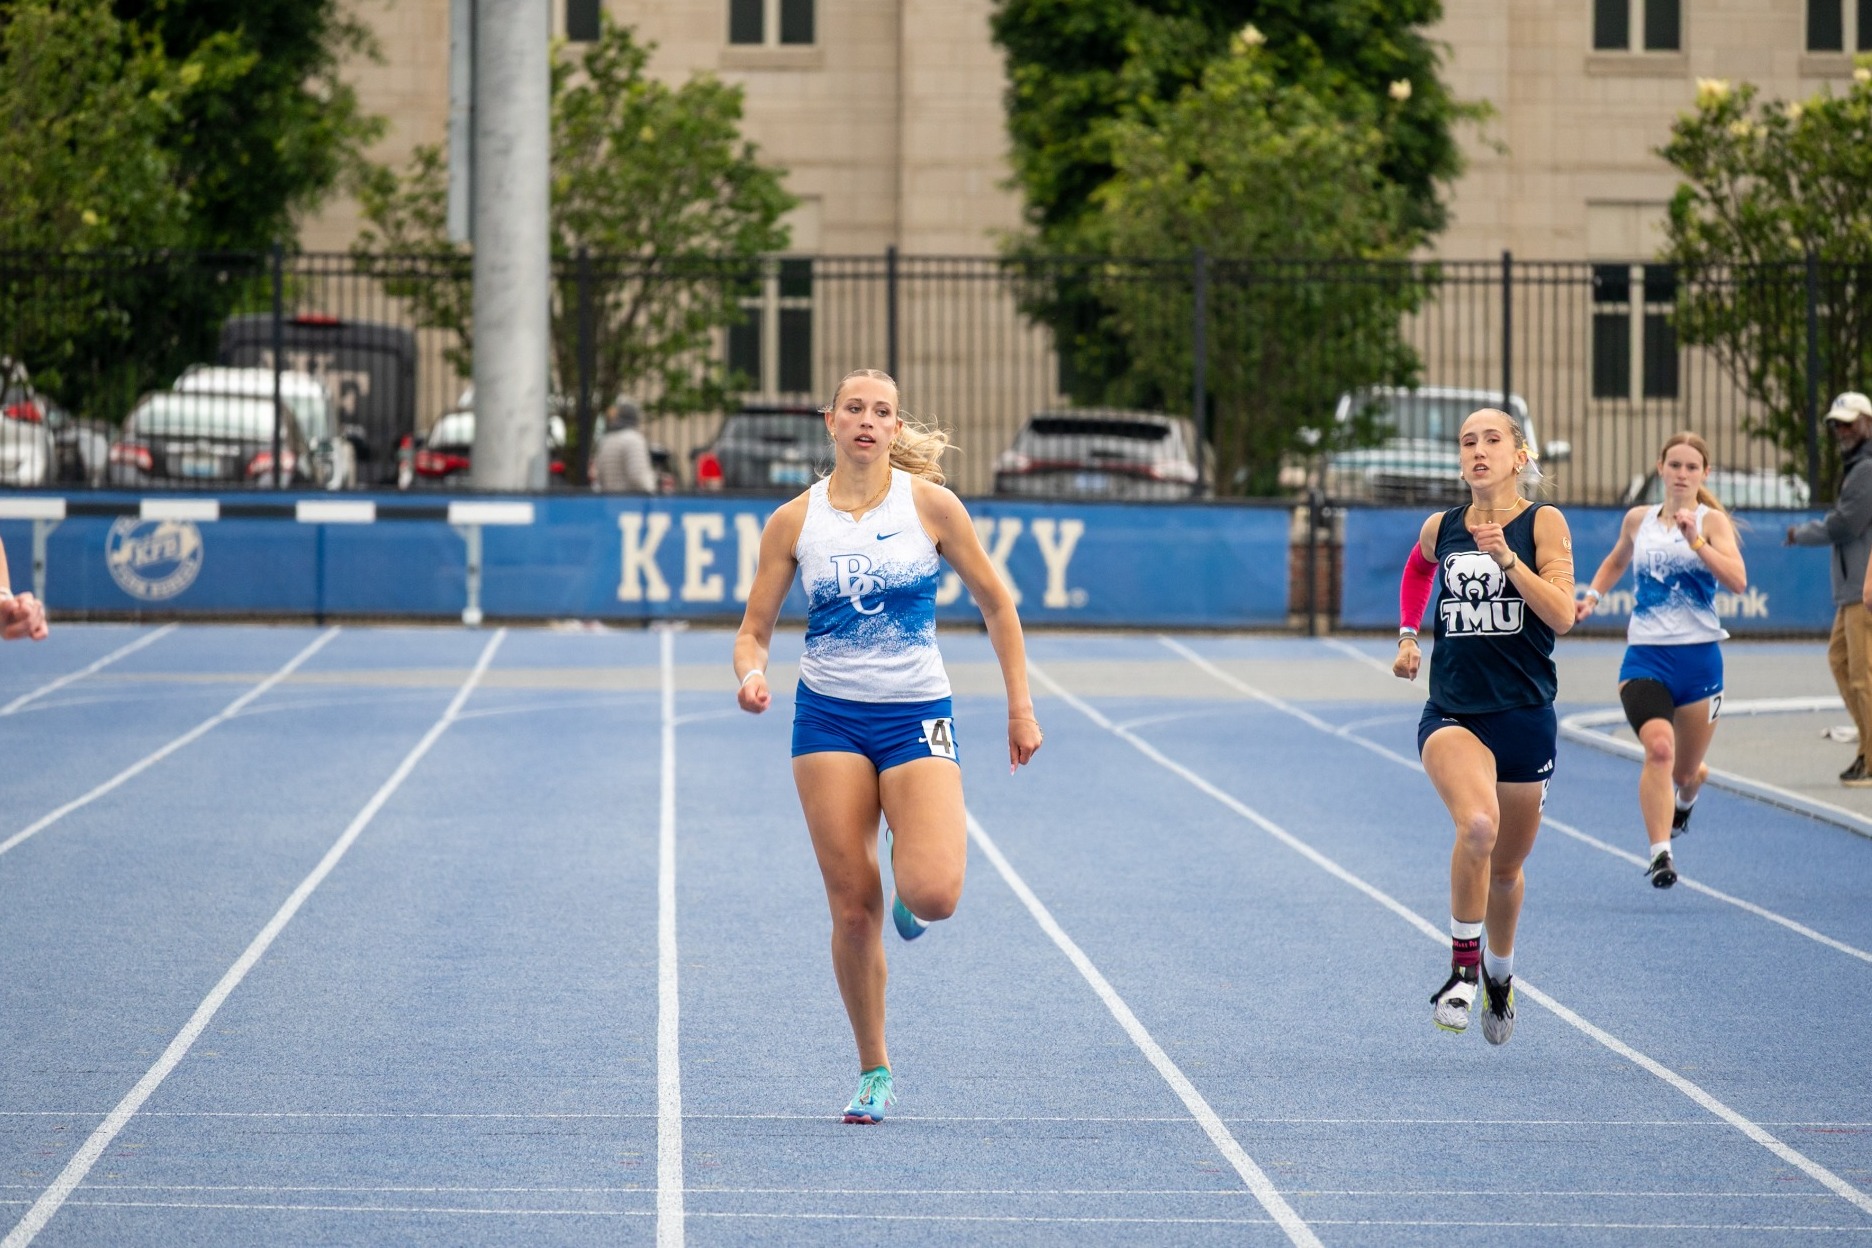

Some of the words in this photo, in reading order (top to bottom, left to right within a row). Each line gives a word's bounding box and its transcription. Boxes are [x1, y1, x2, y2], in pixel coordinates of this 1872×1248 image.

[618, 511, 1085, 608] KENKY
[830, 553, 887, 616] BC
[1442, 600, 1522, 632] TMU
[1716, 586, 1768, 618] ank
[1712, 695, 1722, 720] 2
[931, 719, 951, 755] 4
